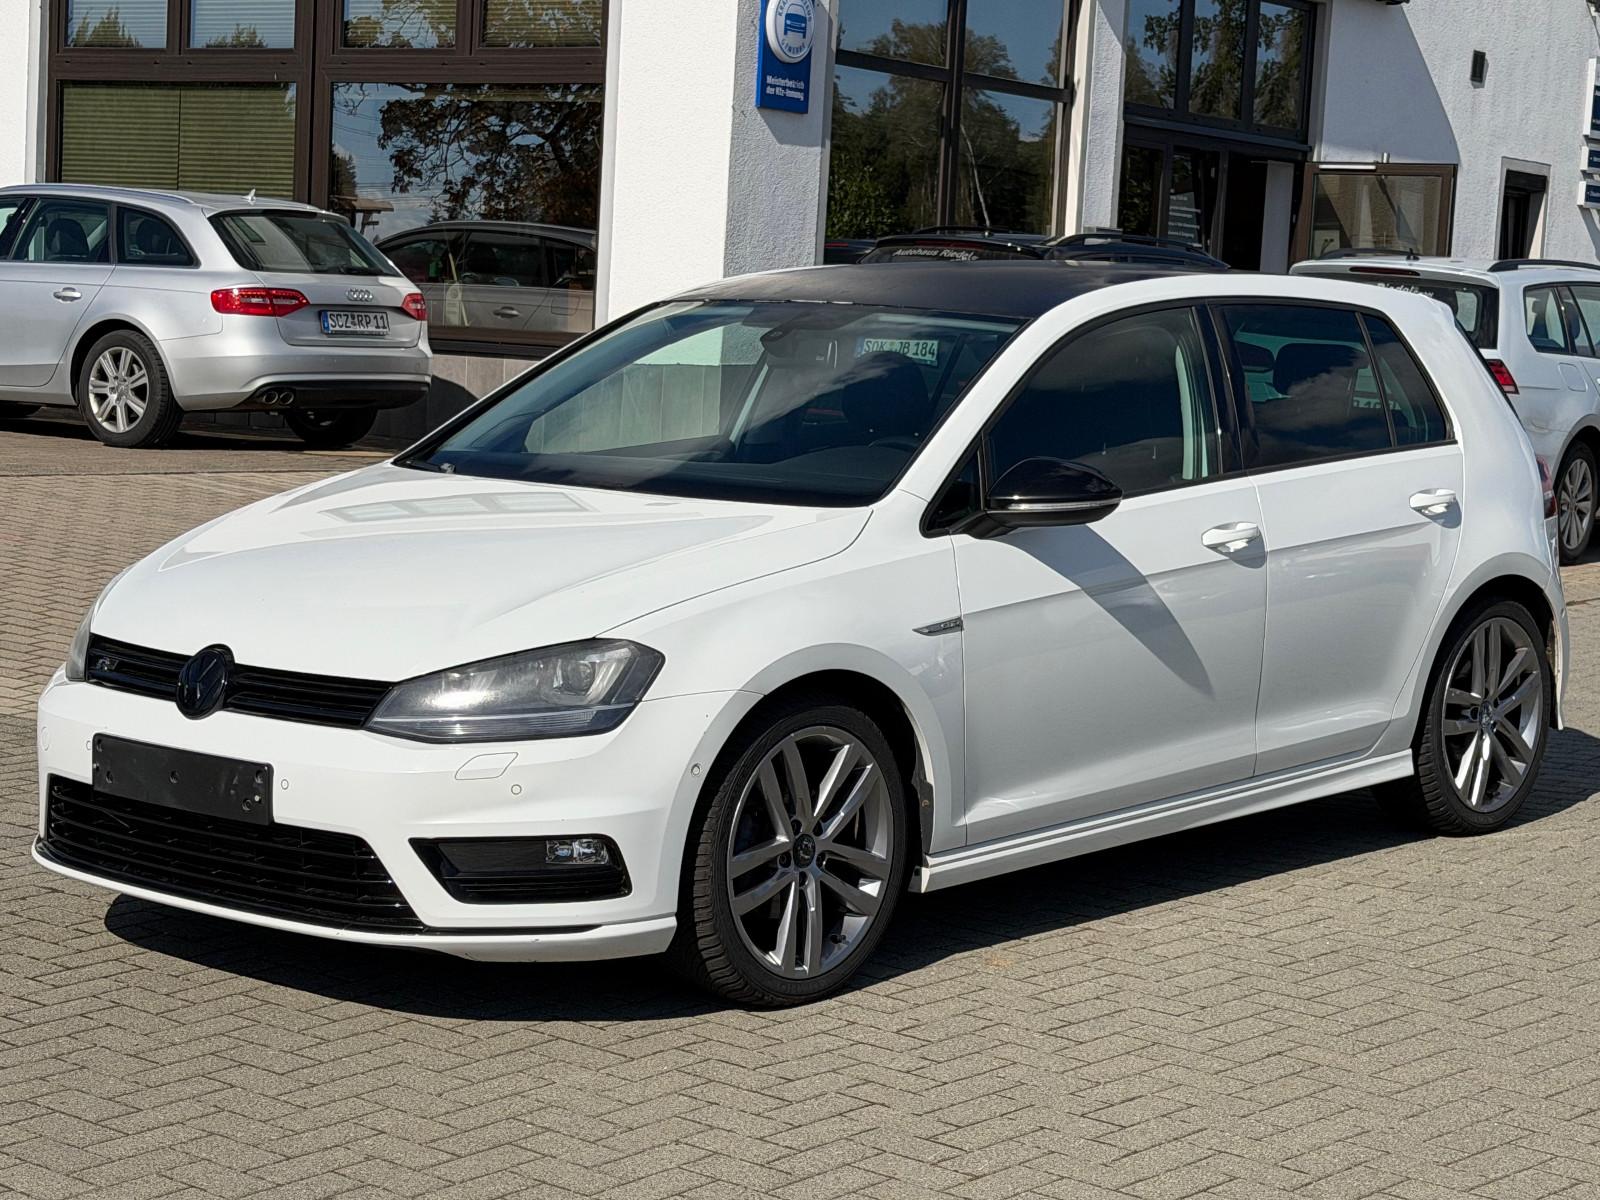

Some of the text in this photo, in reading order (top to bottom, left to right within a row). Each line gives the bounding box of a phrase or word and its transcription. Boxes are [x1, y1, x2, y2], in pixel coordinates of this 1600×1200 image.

[892, 248, 939, 257] Autohaus
[940, 249, 974, 261] Riedel
[329, 313, 387, 329] SCZ RP 11
[912, 341, 936, 358] 184
